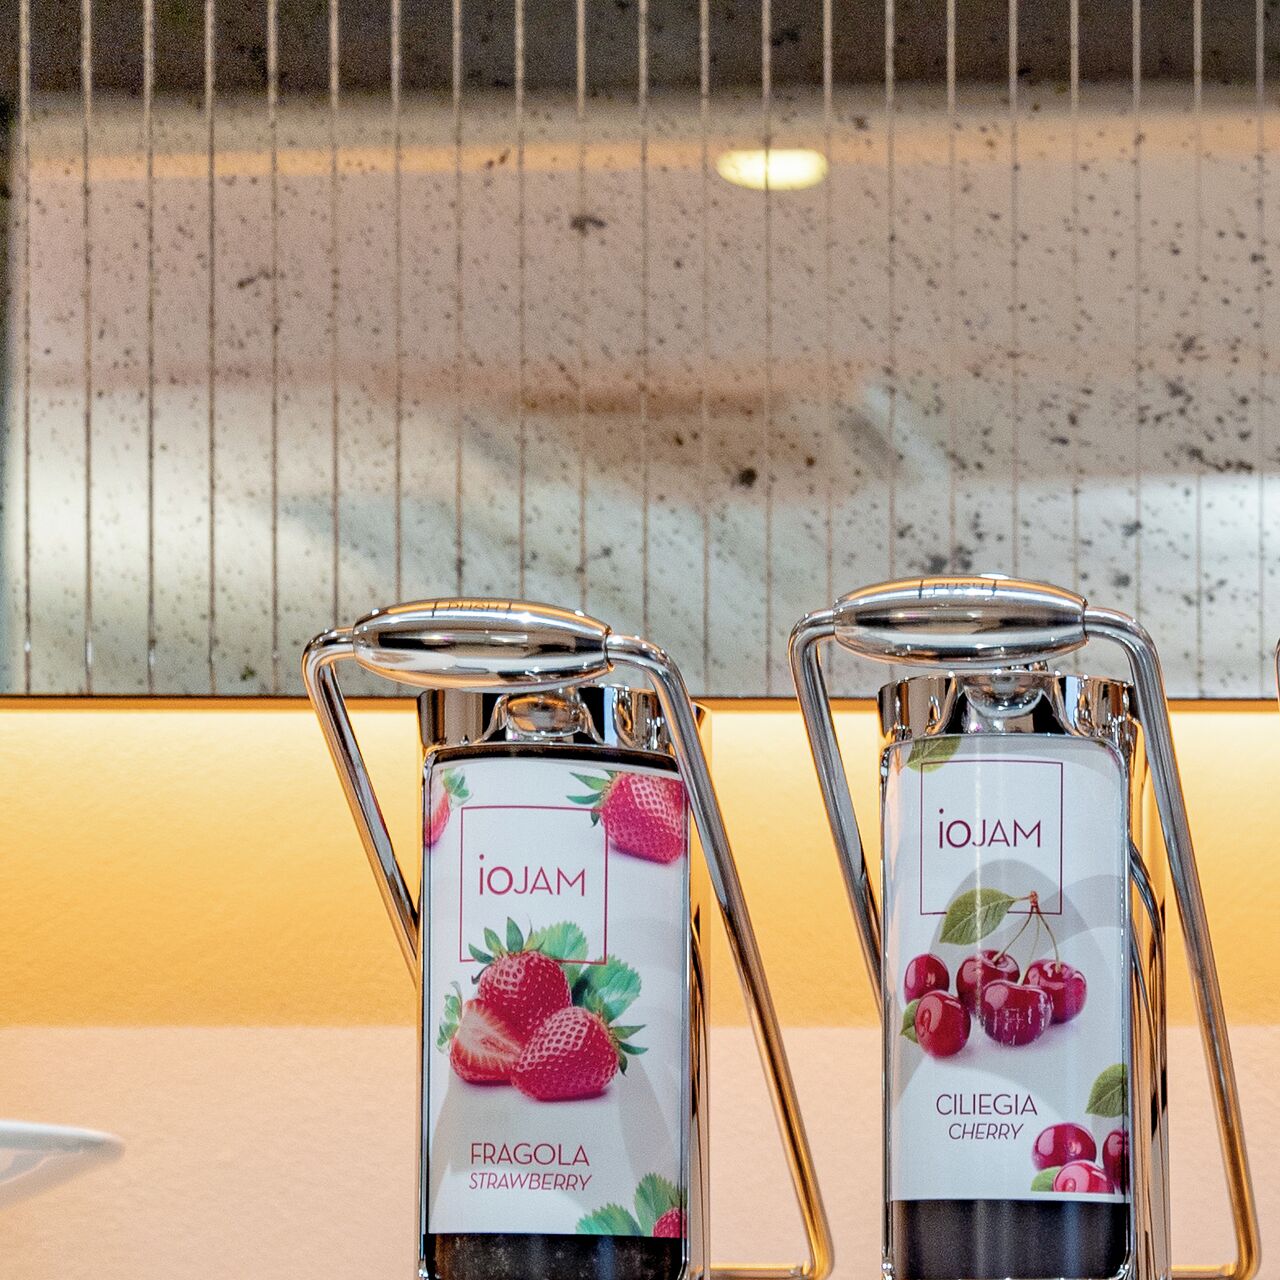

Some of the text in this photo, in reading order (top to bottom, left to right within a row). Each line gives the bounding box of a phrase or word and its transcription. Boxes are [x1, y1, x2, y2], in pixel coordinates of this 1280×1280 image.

[934, 583, 985, 592] PUSH
[936, 1093, 1038, 1117] CILIEGIA
[947, 1122, 1025, 1141] CHERRY
[470, 1143, 590, 1168] FRAGOLA
[468, 1172, 593, 1192] STRAWBERRY
